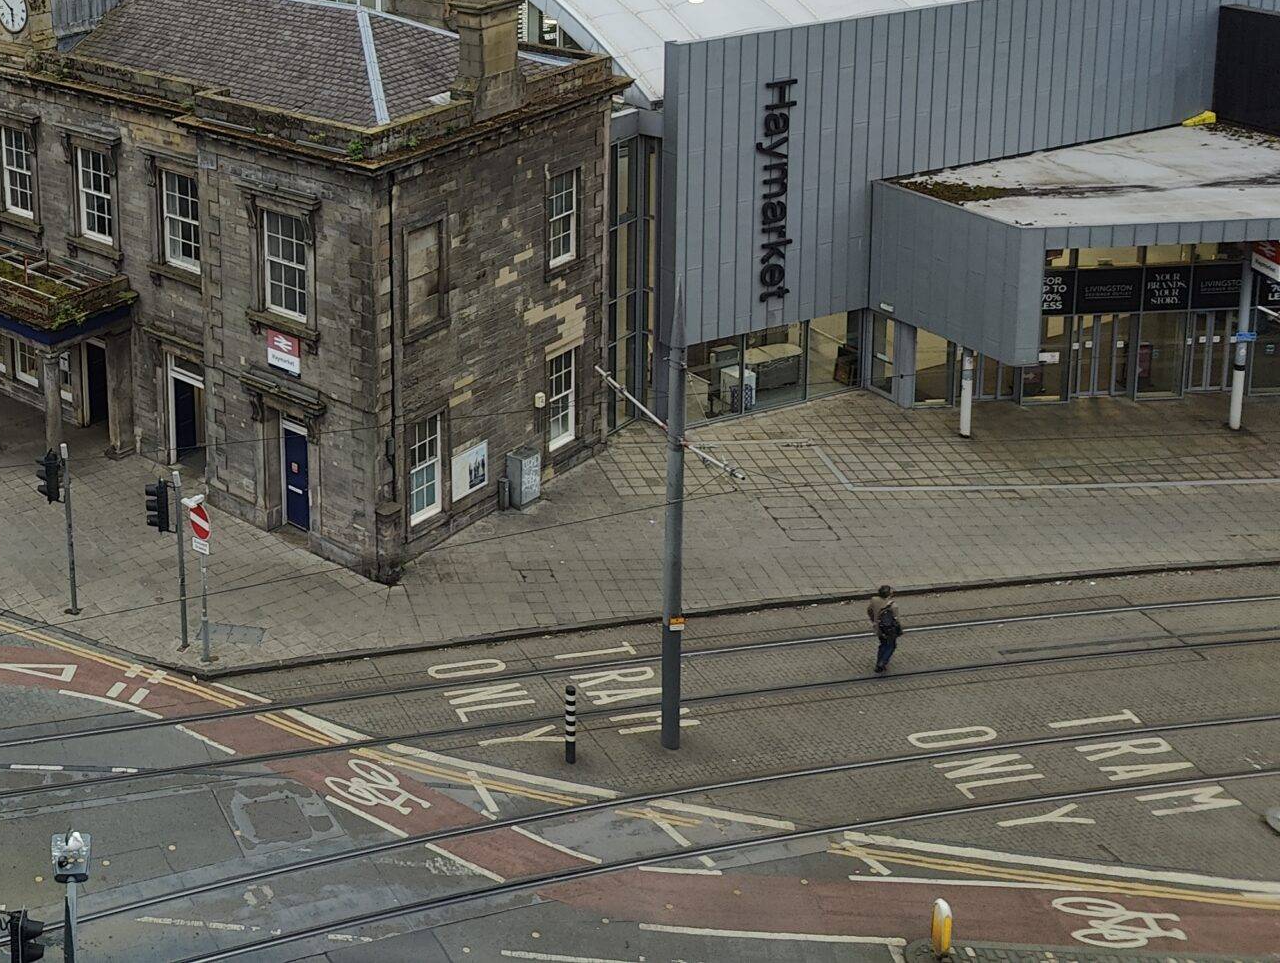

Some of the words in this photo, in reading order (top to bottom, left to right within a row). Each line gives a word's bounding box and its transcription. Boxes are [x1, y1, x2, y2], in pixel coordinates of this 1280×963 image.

[755, 78, 798, 303] Haymarket
[1155, 273, 1181, 281] YOUR
[1200, 279, 1243, 288] LIVINGSTO
[1053, 285, 1068, 293] TO
[1085, 284, 1133, 293] LIVINGSTON
[1154, 288, 1180, 297] YOUR
[427, 658, 568, 746] ONLY
[1047, 709, 1242, 817] TRAM
[907, 725, 1097, 828] ONLY
